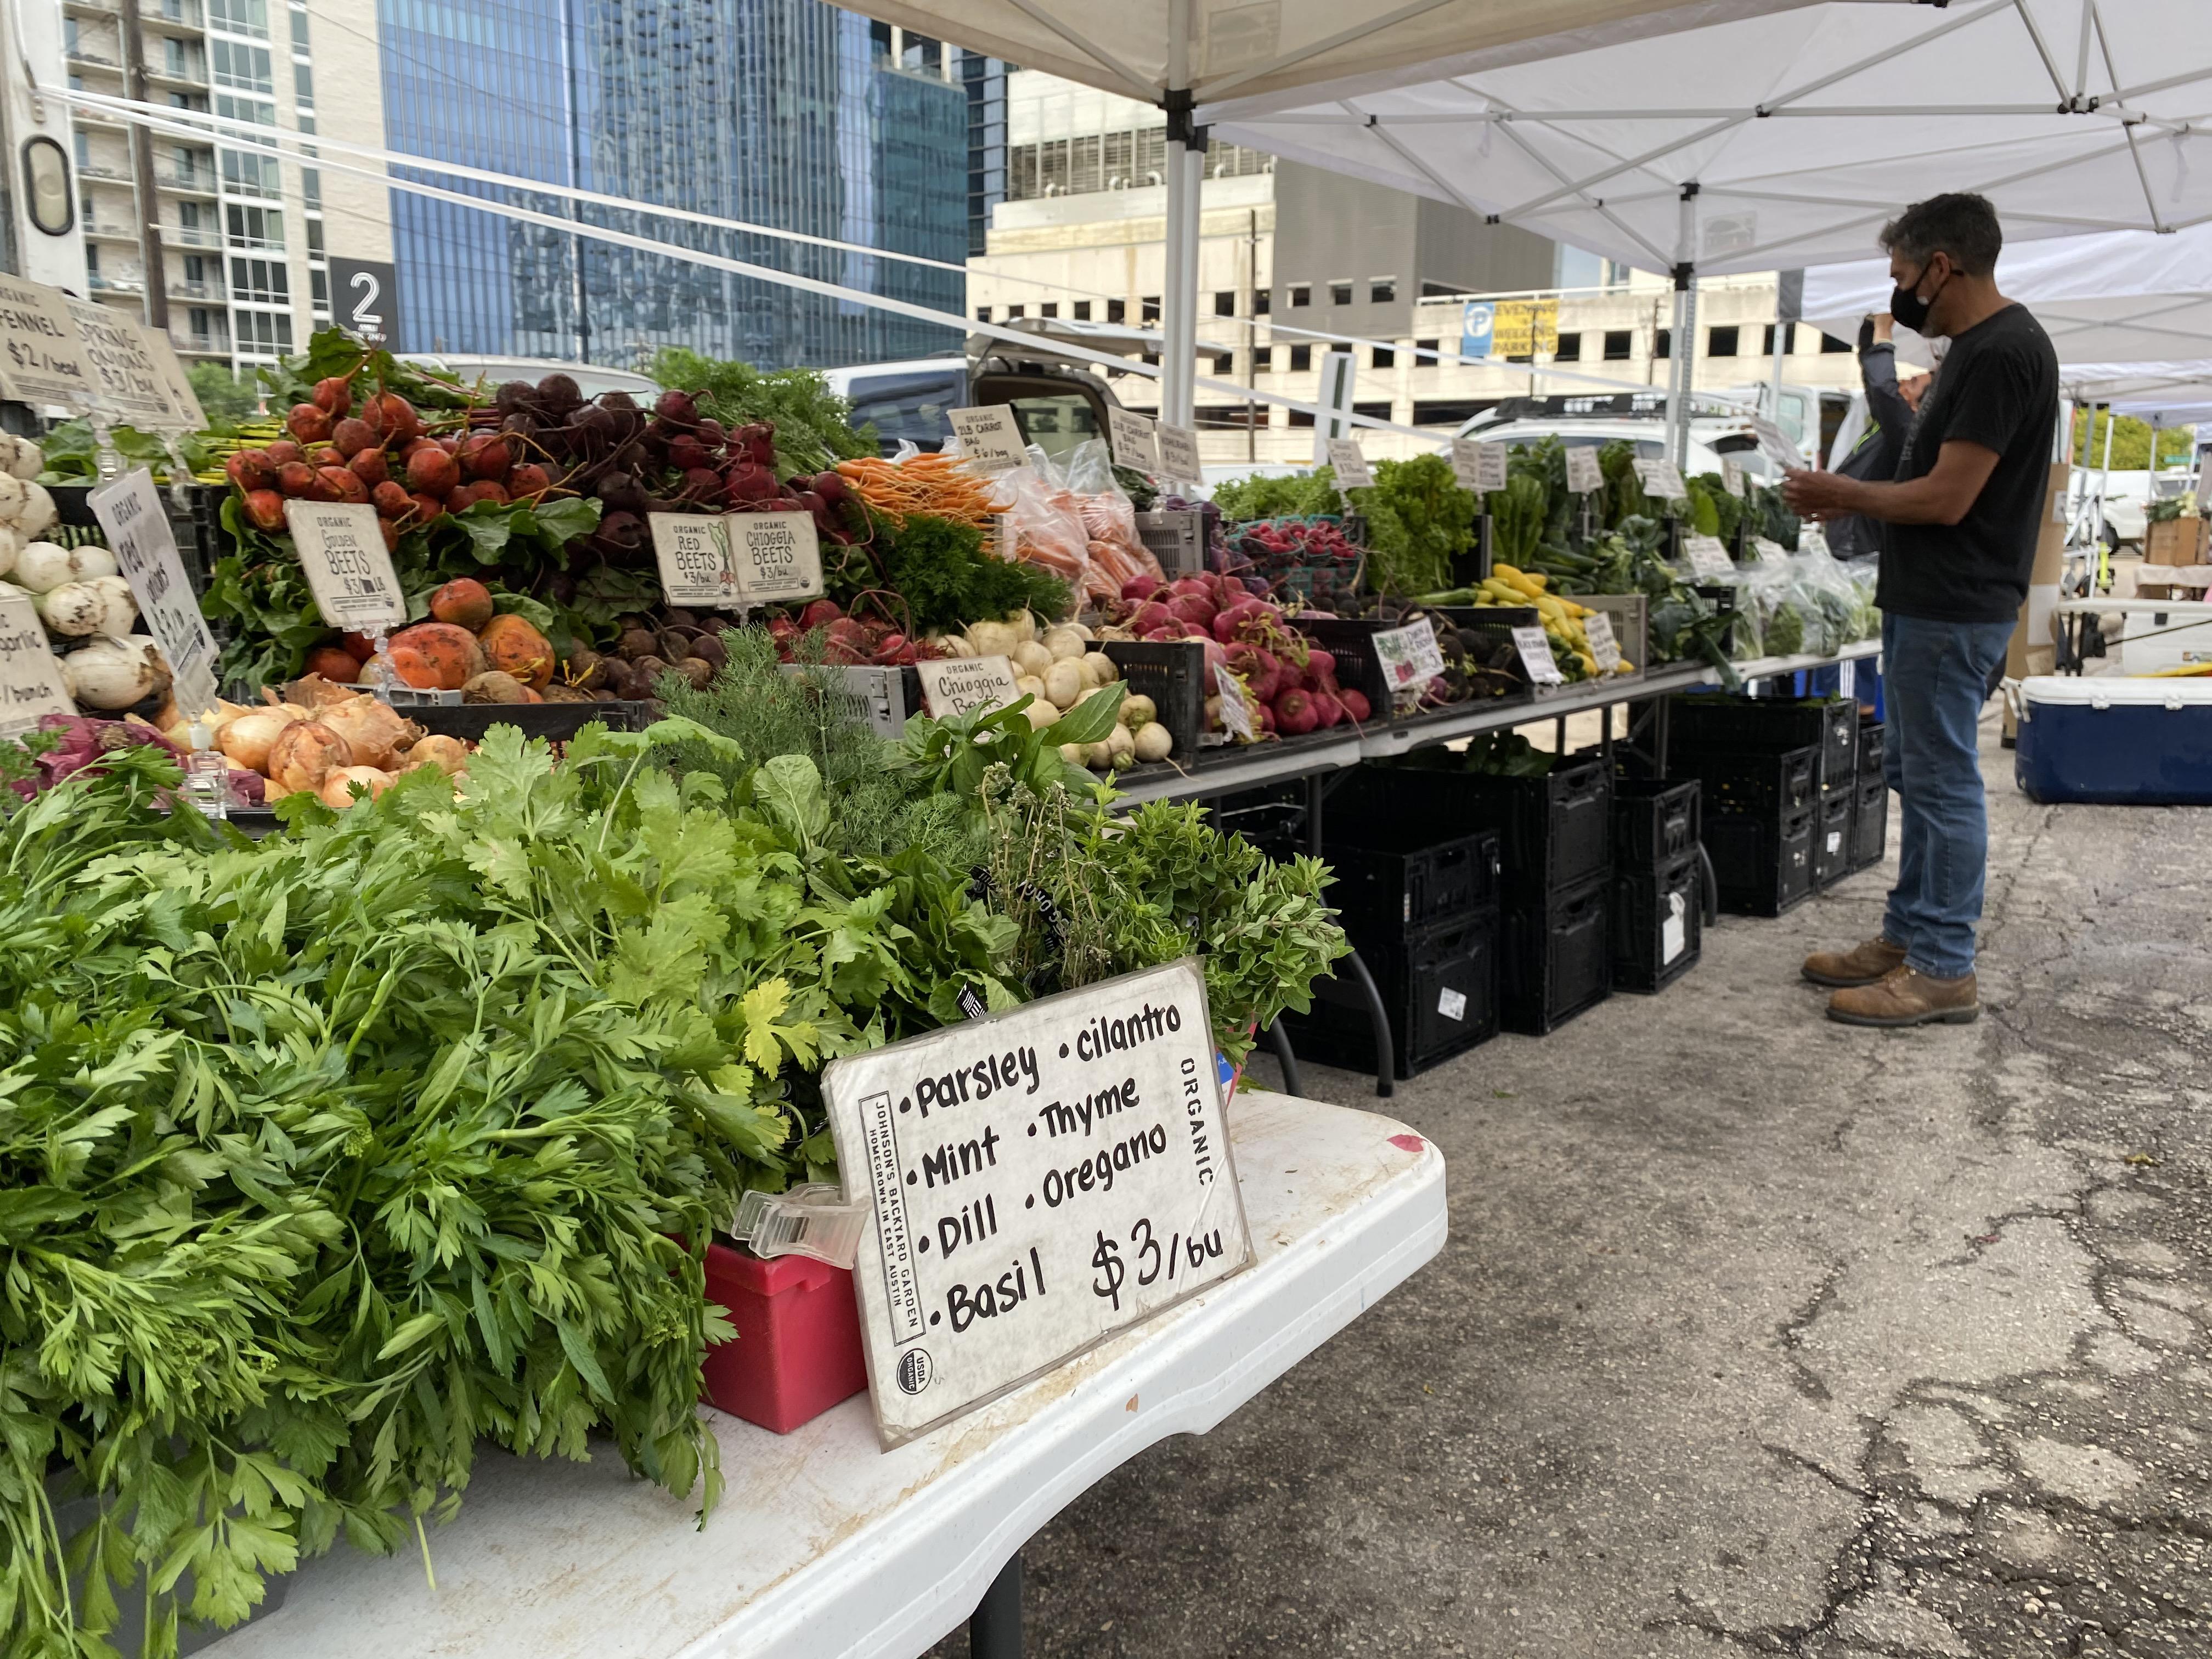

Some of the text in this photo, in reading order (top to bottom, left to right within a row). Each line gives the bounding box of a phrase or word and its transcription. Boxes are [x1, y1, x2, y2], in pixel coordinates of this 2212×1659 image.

[350, 272, 382, 324] 2
[0, 308, 66, 337] ENNEL
[1493, 340, 1555, 353] PARKNG
[958, 421, 1003, 435] 2LB CARROT
[964, 437, 980, 447] BAG
[317, 517, 352, 528] ORGANIC
[673, 525, 706, 534] ORGANIC
[753, 521, 787, 531] ORGANIC
[321, 529, 358, 549] GOLDEN
[678, 535, 700, 550] RED
[747, 531, 796, 547] CHIOGGIA
[325, 550, 370, 575] BEETS
[675, 551, 716, 571] BEETS
[751, 546, 793, 566] BEETS
[946, 663, 984, 674] ORGANIC
[939, 674, 1009, 699] Chioggia
[952, 695, 1004, 716] Bes
[915, 1003, 1181, 1119] Parsley cilantro
[922, 1077, 1140, 1189] Mint Thyme
[1181, 1057, 1214, 1186] ORGANIC
[938, 1123, 1167, 1260] Dill Oregano
[869, 1128, 902, 1307] HOMEGROWN IN EAST AUSTIN
[876, 1101, 918, 1328] JOHNSON'S BACKYARD GARDEN
[947, 1246, 1046, 1333] Basil
[906, 1357, 916, 1390] ORGANIC
[916, 1356, 926, 1384] USDA
